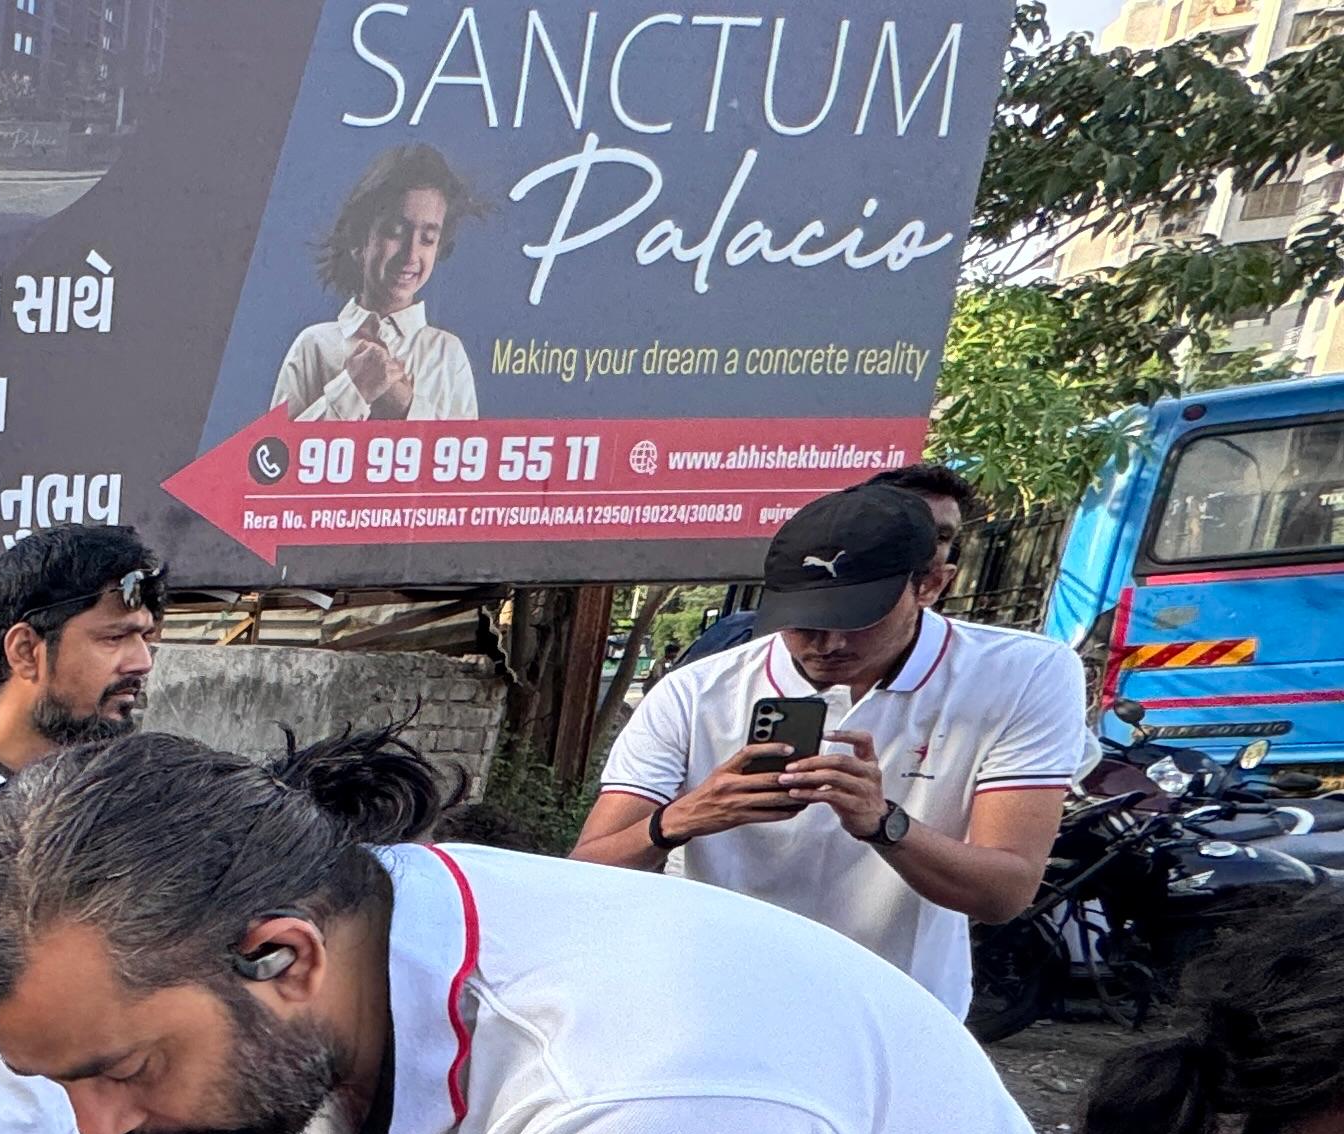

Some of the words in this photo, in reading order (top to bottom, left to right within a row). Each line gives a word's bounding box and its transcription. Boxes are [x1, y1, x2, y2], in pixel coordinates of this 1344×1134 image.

[341, 2, 963, 138] SANCTUM
[508, 132, 953, 305] Palacio
[12, 249, 114, 333] સાથે
[491, 339, 577, 383] Making
[584, 345, 636, 383] your
[642, 340, 718, 375] dream
[724, 349, 739, 375] a
[745, 343, 849, 375] concrete
[853, 342, 930, 383] reality
[297, 436, 355, 484] 90
[365, 436, 422, 483] 99
[432, 436, 488, 483] 99
[497, 436, 555, 482] 55
[565, 436, 600, 481] 11
[668, 444, 906, 470] www.abhishekbuilders.in
[243, 510, 278, 530] Rera
[282, 510, 307, 530] No.
[311, 507, 467, 530] PR/GJ/SURAT/SURAT
